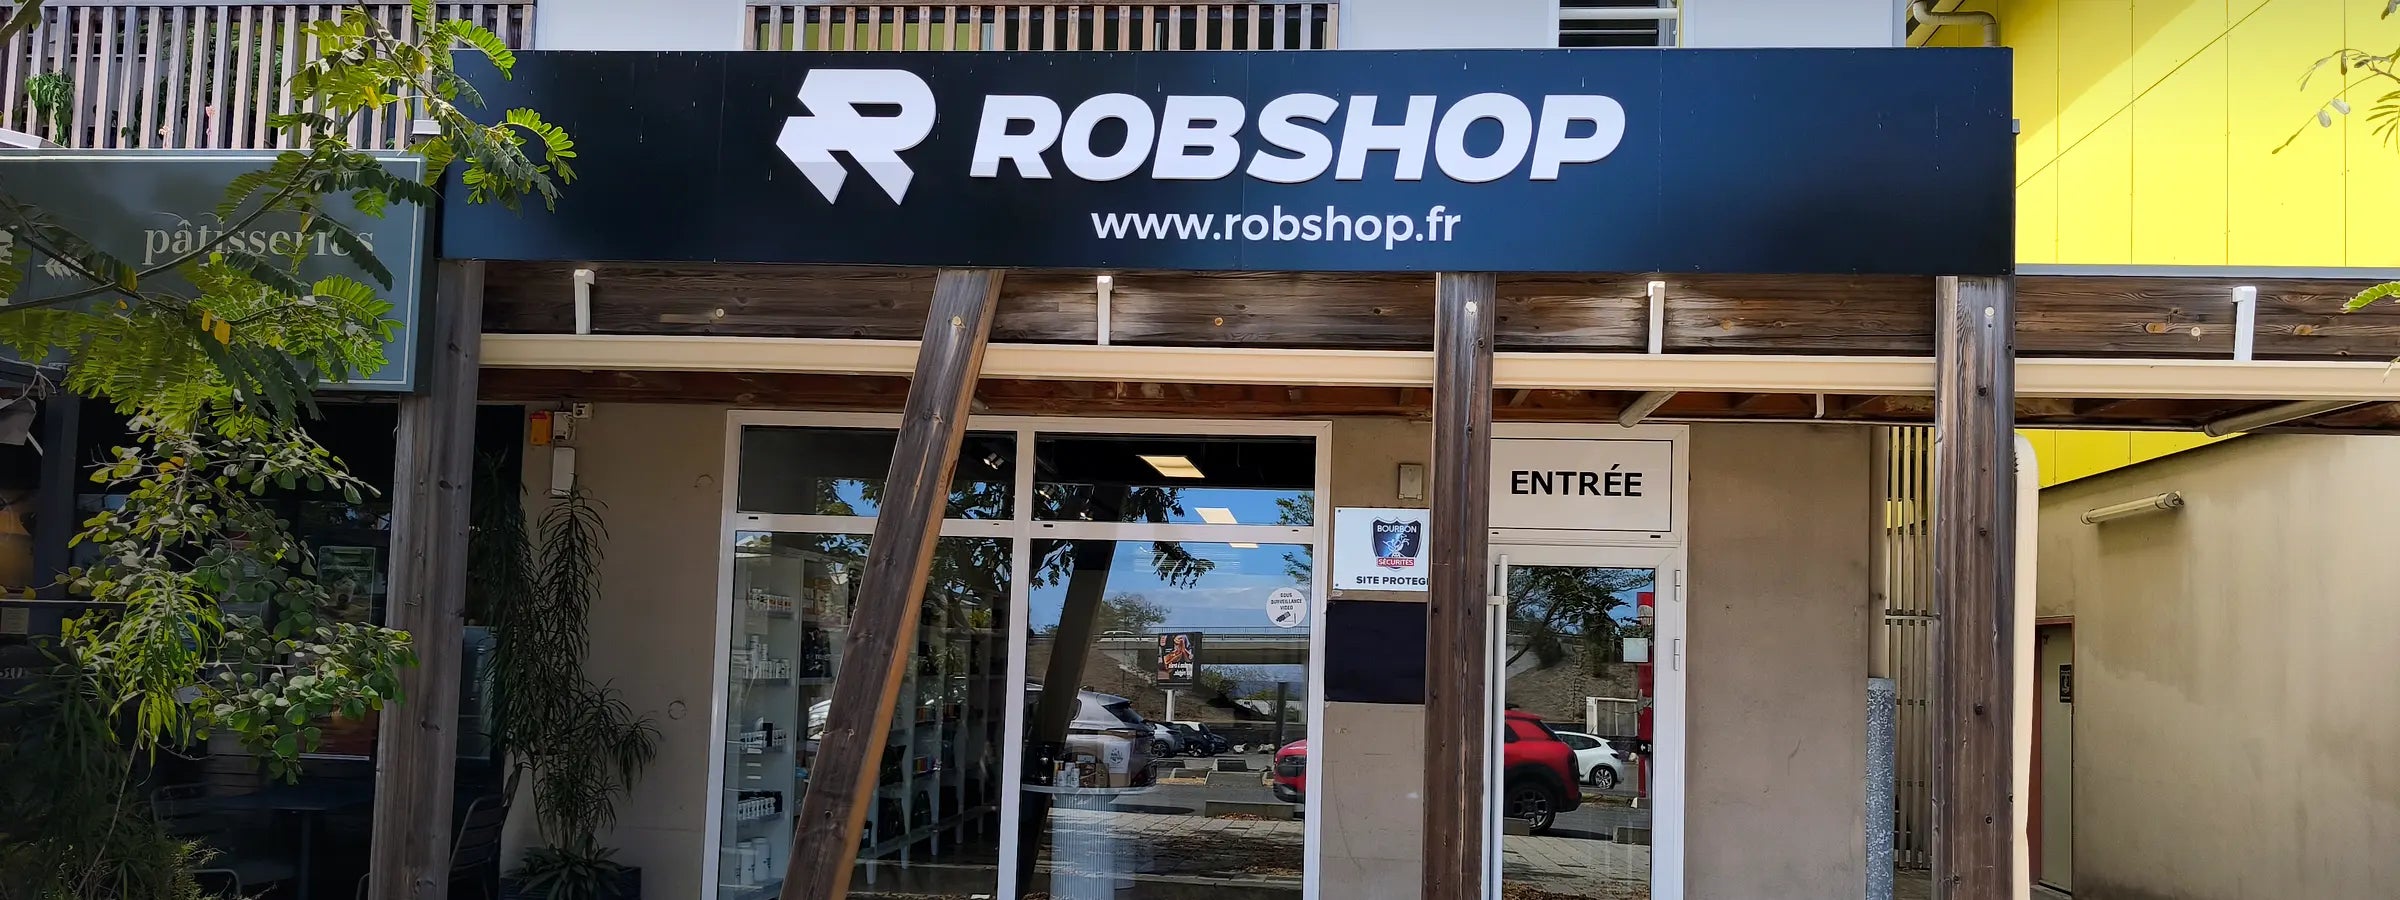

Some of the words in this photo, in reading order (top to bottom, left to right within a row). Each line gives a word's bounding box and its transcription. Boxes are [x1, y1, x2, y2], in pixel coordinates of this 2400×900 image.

[969, 93, 1626, 184] ROBSHOP
[1091, 205, 1462, 250] www.robshop.fr
[1511, 463, 1643, 497] ENTRÉE
[1377, 525, 1417, 533] BOURBON
[1356, 576, 1379, 585] SITE
